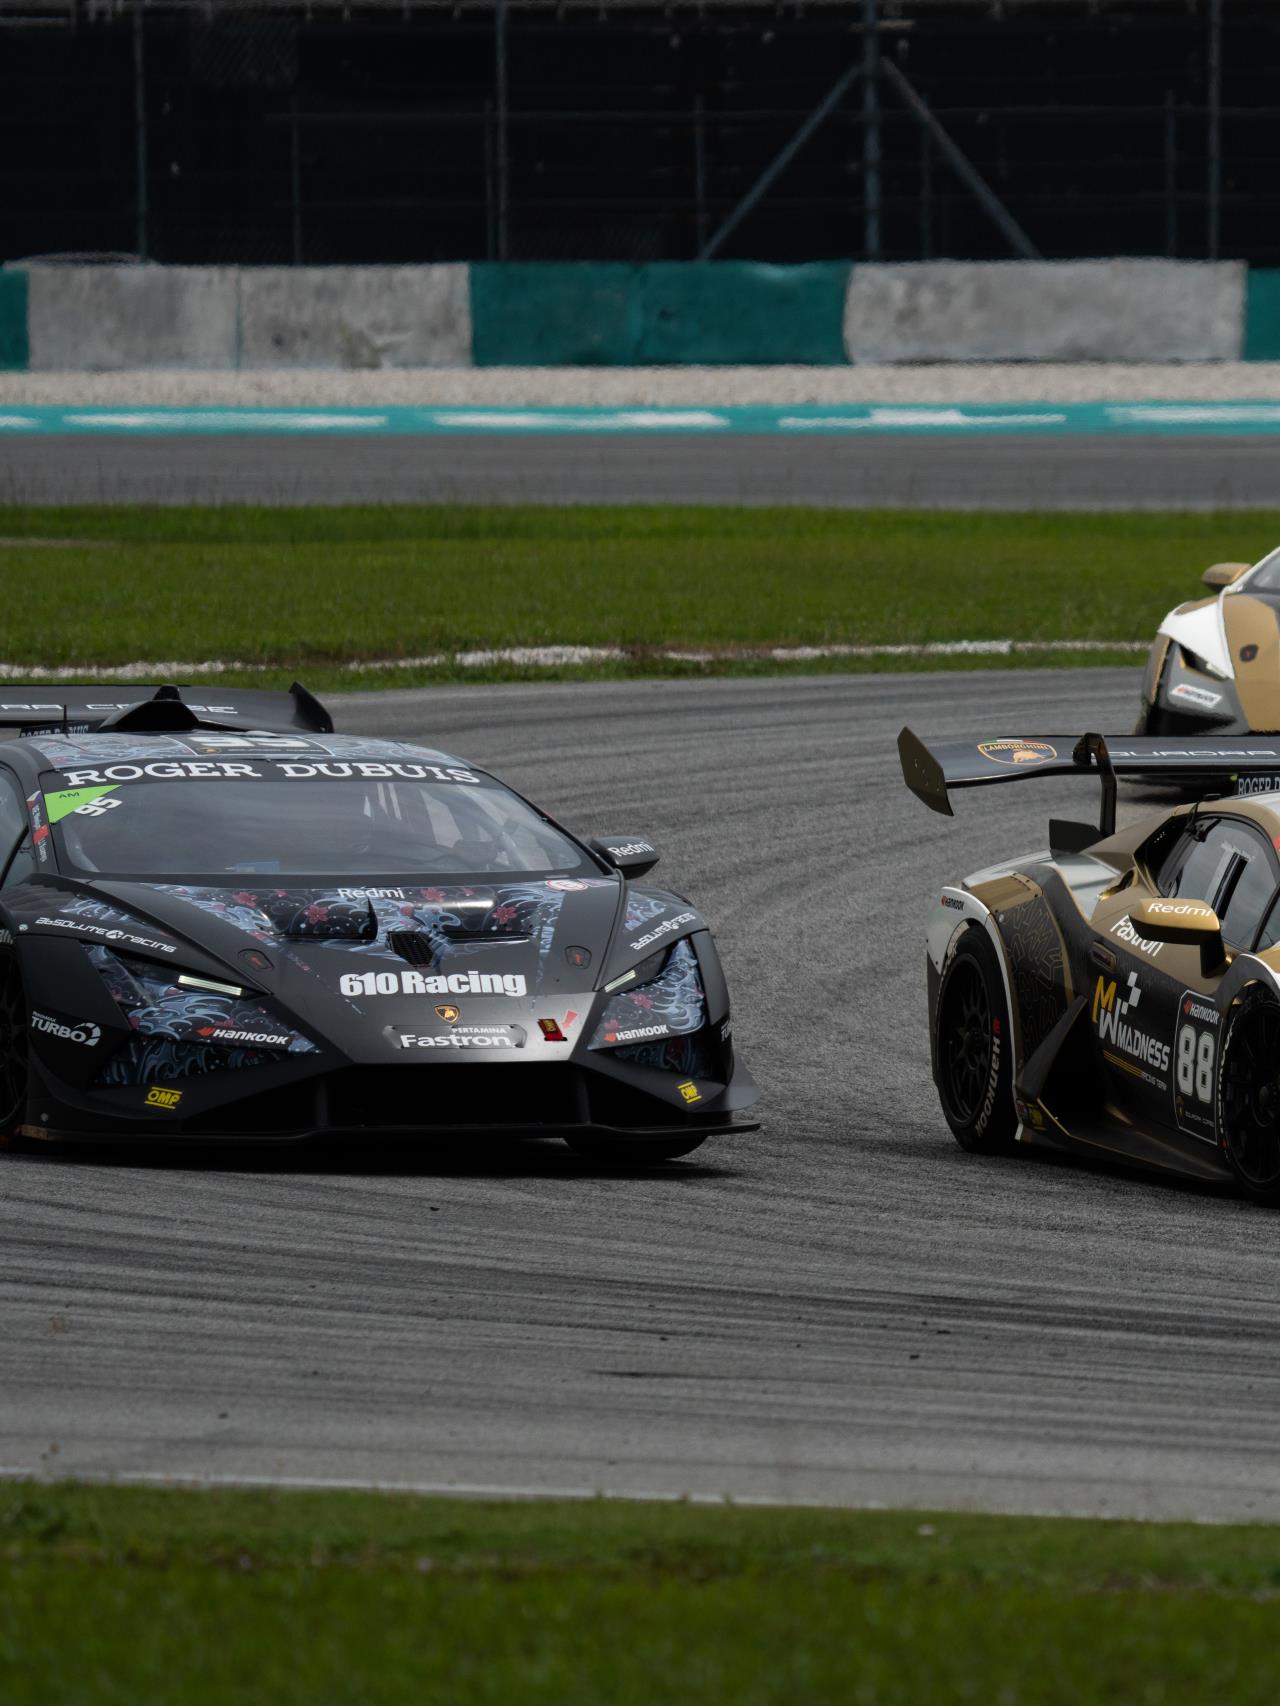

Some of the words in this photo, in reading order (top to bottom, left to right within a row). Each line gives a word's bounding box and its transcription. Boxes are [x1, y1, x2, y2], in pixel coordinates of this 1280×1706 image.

[982, 743, 1050, 751] LAMBORGHINI
[64, 762, 262, 787] ROGER
[277, 762, 481, 784] DUBUIS
[75, 797, 123, 817] 95
[608, 841, 654, 858] Redmi
[337, 887, 405, 900] Redmi
[1148, 902, 1213, 917] Redmi
[339, 972, 399, 997] 610
[401, 970, 527, 997] Racing
[32, 1015, 87, 1044] TURBO
[400, 1034, 512, 1048] Fastron
[1117, 1025, 1171, 1072] MADNESS
[1176, 1024, 1215, 1104] 88
[147, 1090, 181, 1107] OMP
[681, 1084, 698, 1101] OMP
